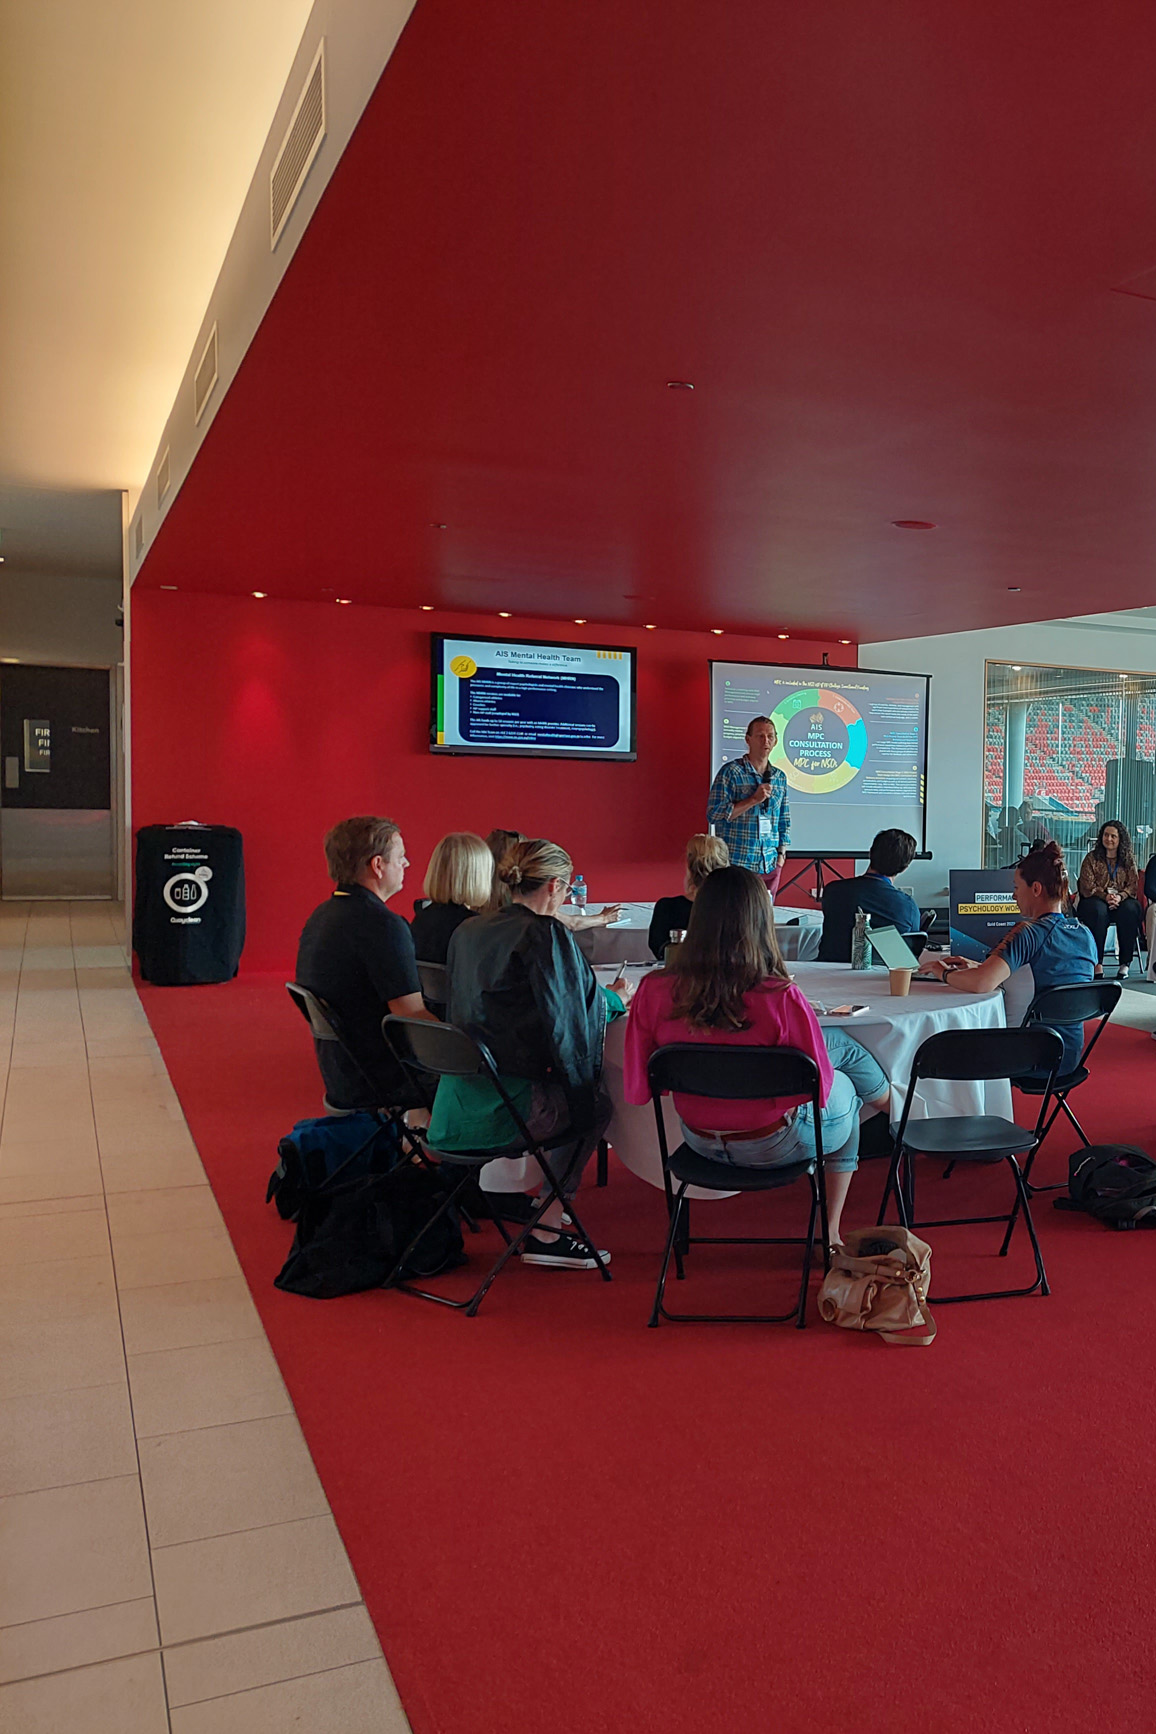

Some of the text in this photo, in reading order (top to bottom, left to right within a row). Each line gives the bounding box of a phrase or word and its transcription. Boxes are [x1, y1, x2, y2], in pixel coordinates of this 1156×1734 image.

[537, 653, 560, 661] Health
[808, 732, 824, 740] MPC
[789, 740, 843, 749] CONSULTATION
[800, 749, 831, 757] PROCESS
[793, 758, 809, 768] MPC
[811, 760, 820, 770] for
